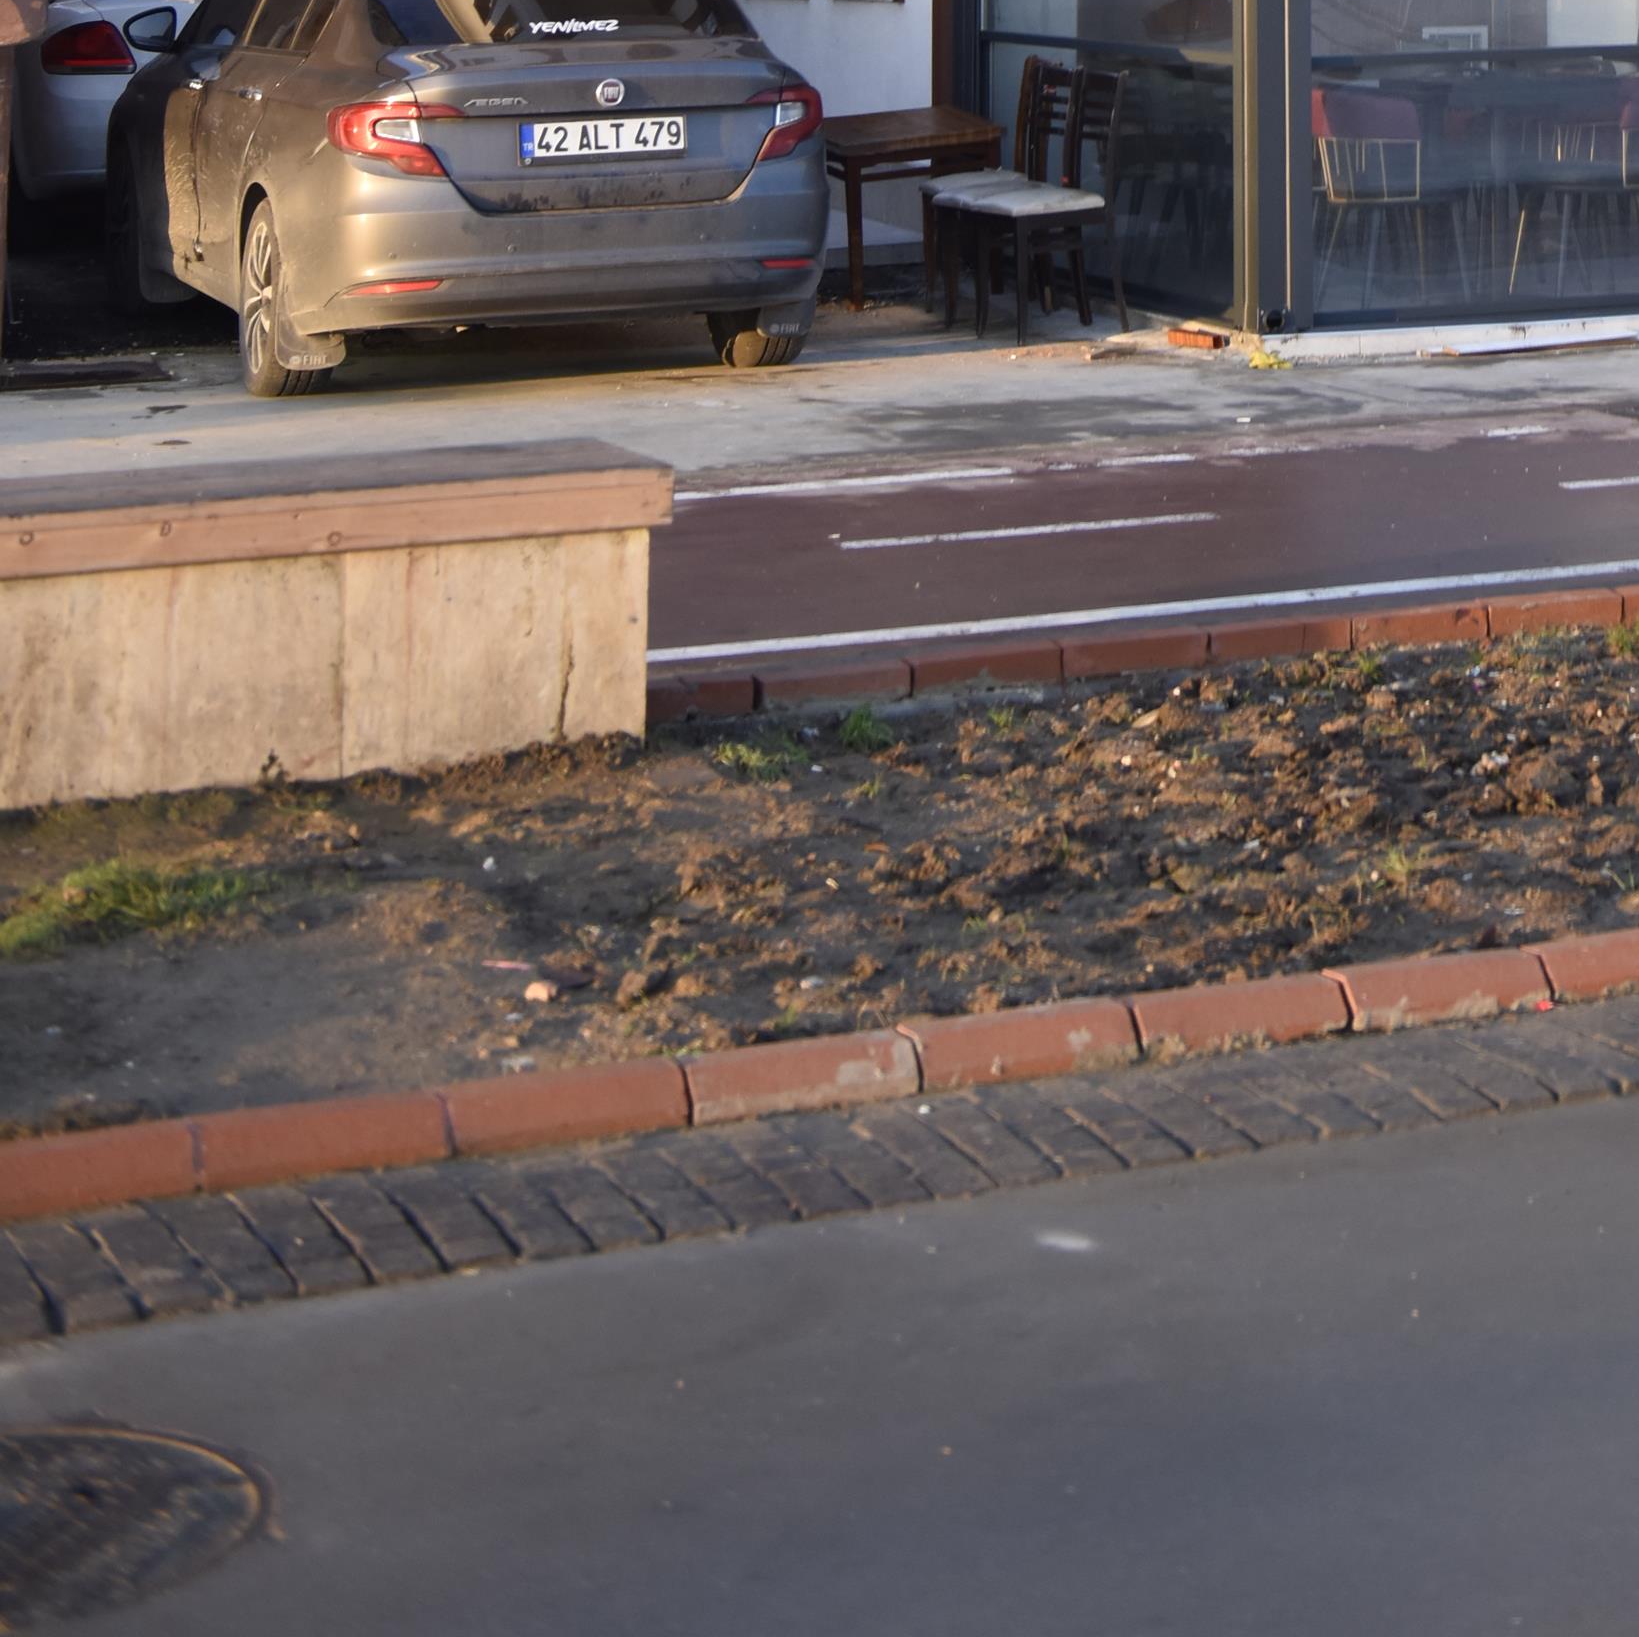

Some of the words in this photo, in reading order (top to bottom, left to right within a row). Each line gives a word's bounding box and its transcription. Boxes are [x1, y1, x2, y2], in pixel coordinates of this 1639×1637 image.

[529, 18, 619, 35] YENİLMEZ
[537, 125, 569, 154] 42
[578, 122, 625, 152] ALT
[634, 120, 682, 149] 479
[523, 142, 534, 152] TR
